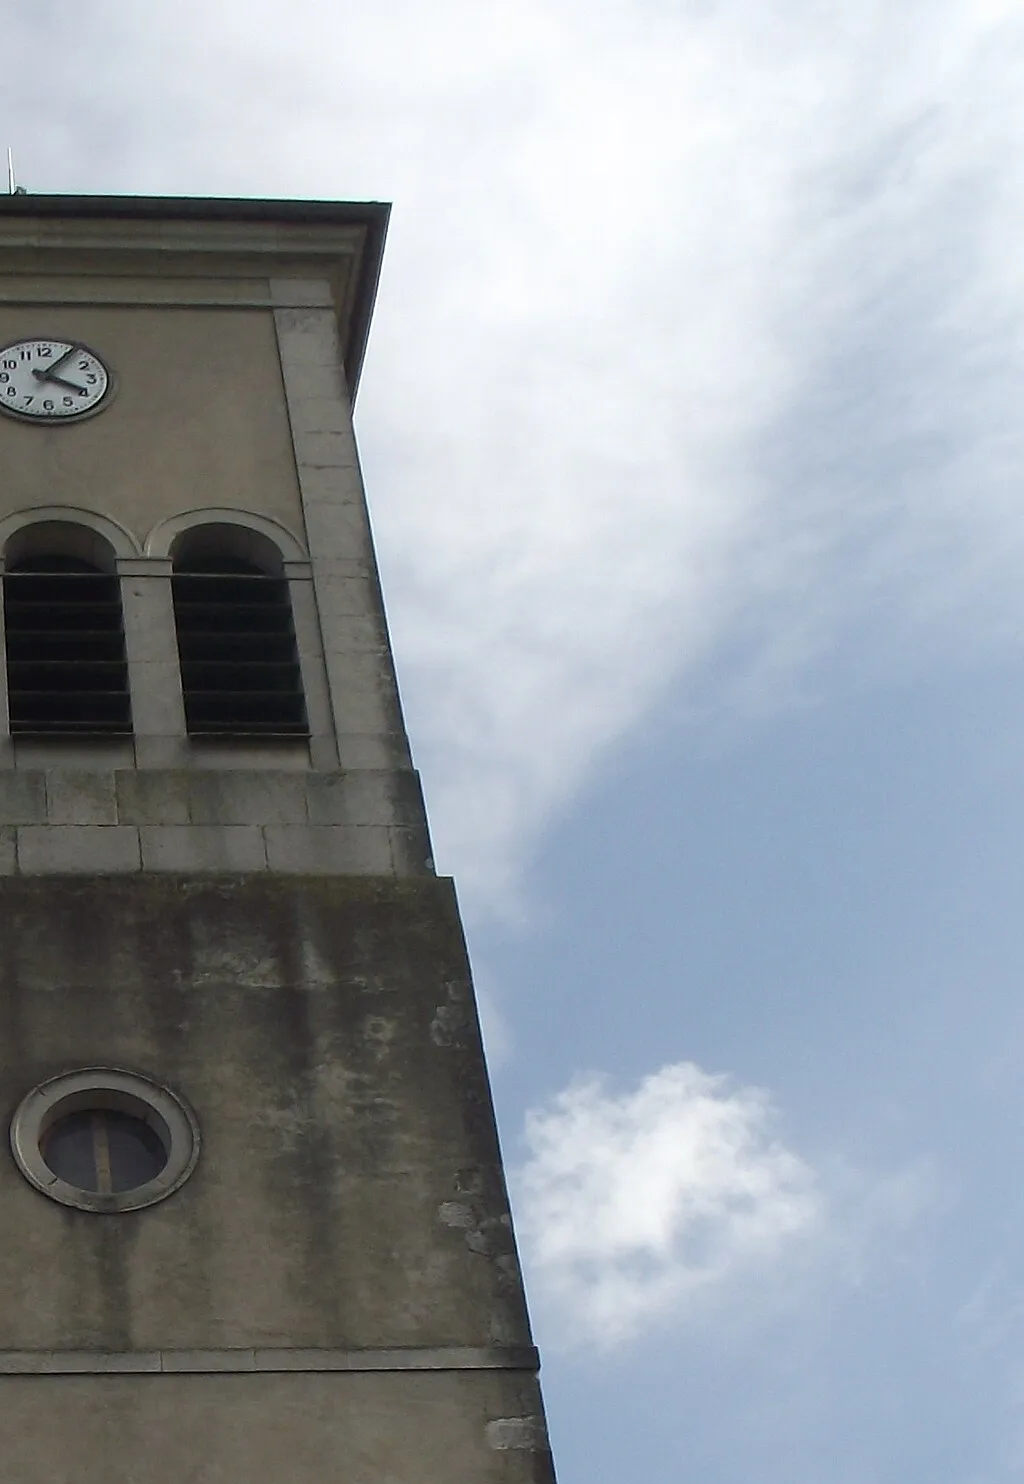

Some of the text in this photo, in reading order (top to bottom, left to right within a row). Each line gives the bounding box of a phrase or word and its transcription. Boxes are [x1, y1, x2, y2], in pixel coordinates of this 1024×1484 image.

[20, 351, 31, 361] 11
[37, 347, 53, 358] 12
[3, 359, 17, 370] 10
[78, 360, 89, 371] 2
[0, 372, 10, 384] 9
[86, 374, 97, 385] 3
[6, 386, 17, 397] 8
[78, 387, 89, 398] 4
[23, 396, 34, 406] 7
[43, 399, 55, 411] 6
[63, 397, 74, 407] 5
